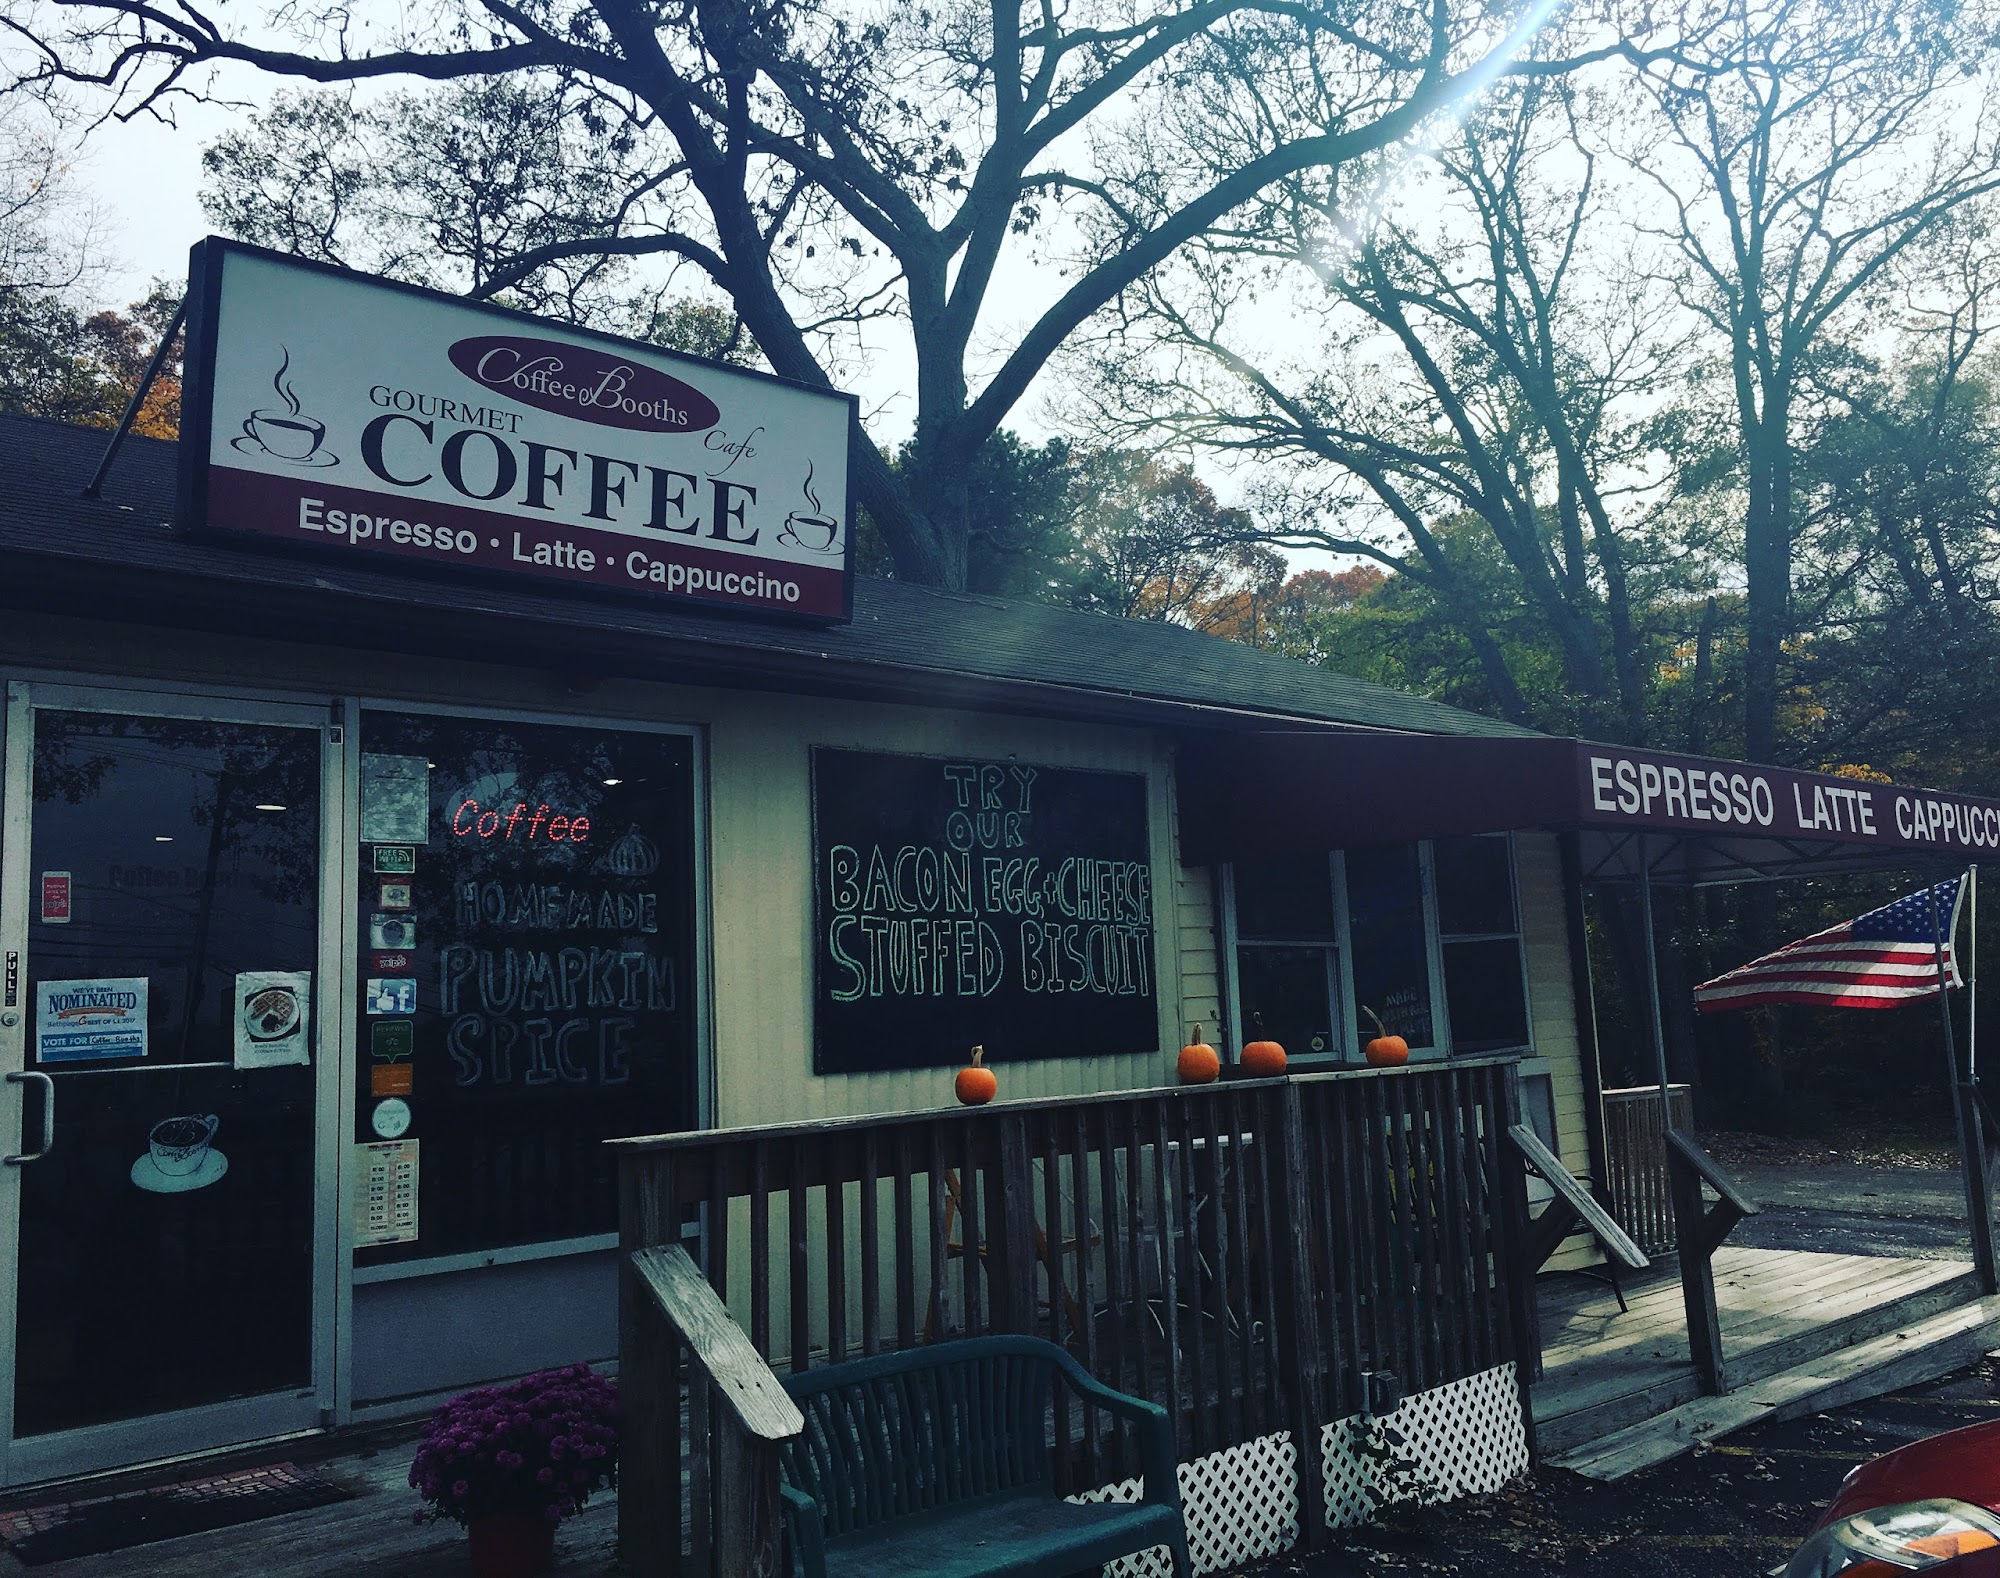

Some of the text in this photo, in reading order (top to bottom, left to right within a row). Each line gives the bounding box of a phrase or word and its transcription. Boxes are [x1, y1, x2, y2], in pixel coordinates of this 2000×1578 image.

[369, 385, 523, 434] GOURMET
[477, 347, 689, 426] Coffee Booths
[704, 427, 765, 476] Cafe
[360, 413, 760, 547] COFFEE
[298, 497, 801, 603] Espresso Latte Cappuccino
[944, 765, 1037, 813] TRY
[1590, 756, 1775, 827] ESPRESSO
[1794, 782, 1878, 836] LATTE
[453, 799, 590, 842] Coffee
[946, 811, 1024, 851] OUR
[455, 879, 658, 934] HOMEMADE
[830, 844, 979, 919] BACON,
[1057, 857, 1151, 926] CHEESE
[7, 952, 17, 989] PULL
[380, 958, 399, 969] yelp
[440, 943, 677, 1018] PUMPKIN
[830, 914, 1149, 1002] STUFFED BISCUIT
[48, 992, 137, 1014] NOMINATED
[43, 1036, 88, 1047] VOTE FOR
[446, 1012, 636, 1087] SPICE
